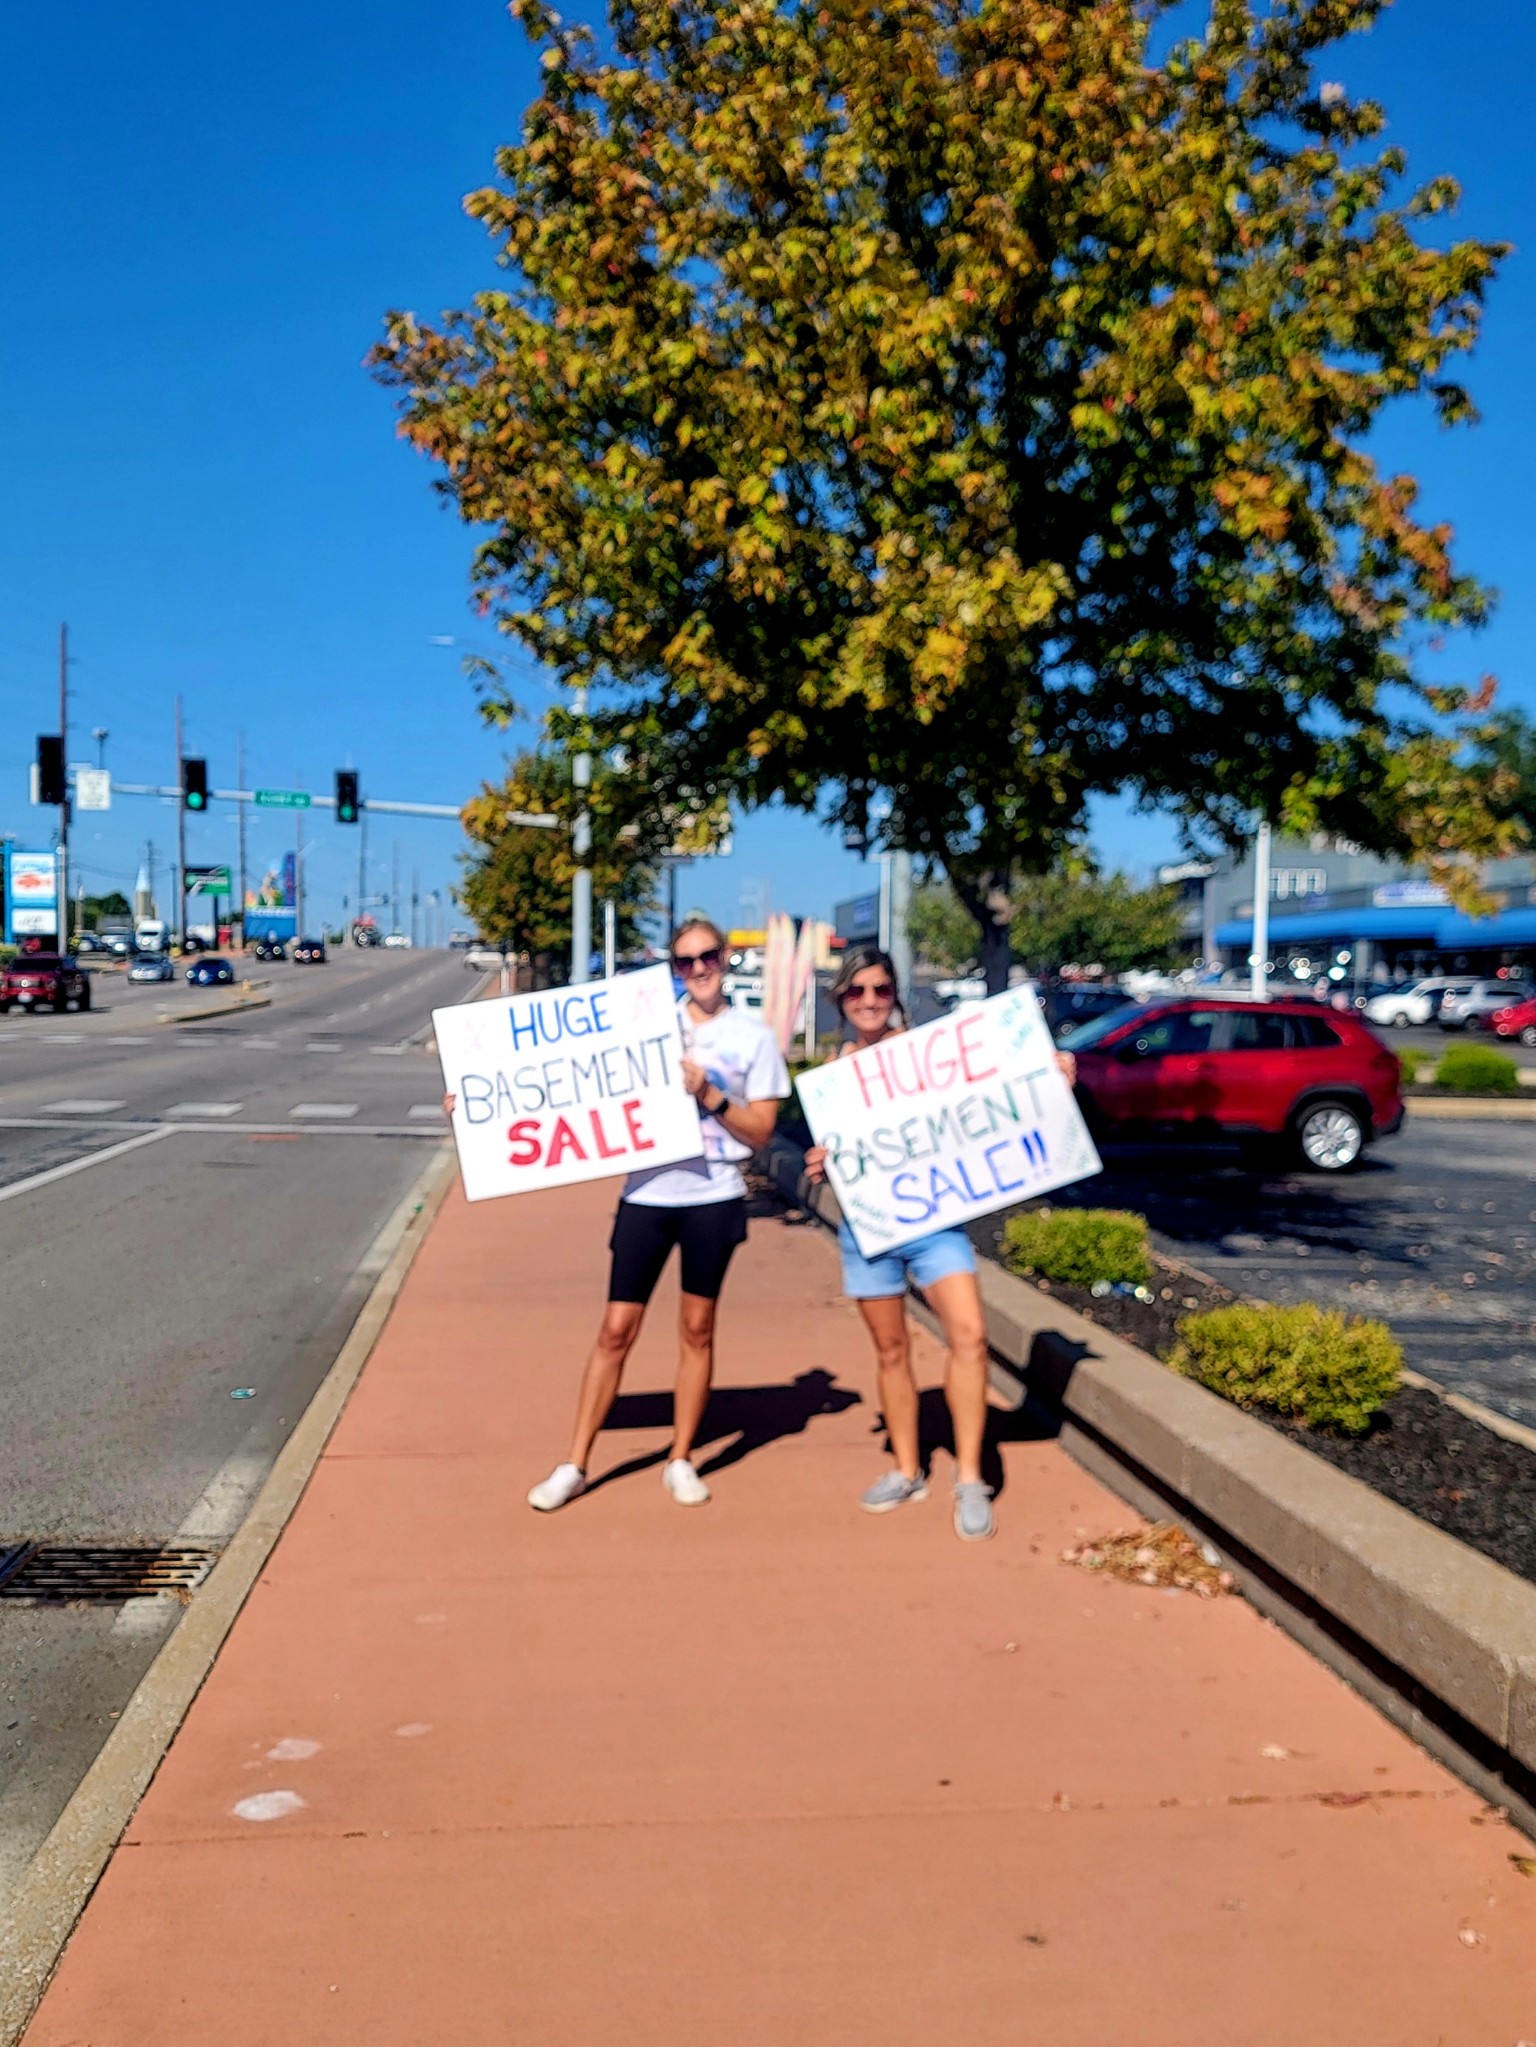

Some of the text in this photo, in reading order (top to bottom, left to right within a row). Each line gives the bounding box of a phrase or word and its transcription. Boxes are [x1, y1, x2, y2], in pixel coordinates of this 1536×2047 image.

[508, 990, 612, 1051] HUGE
[851, 1012, 998, 1108] HUGE
[461, 1033, 672, 1124] BASEMENT
[508, 1099, 655, 1168] SALE
[822, 1067, 1048, 1185] BASEMENT
[891, 1128, 1052, 1224] SALE!!
